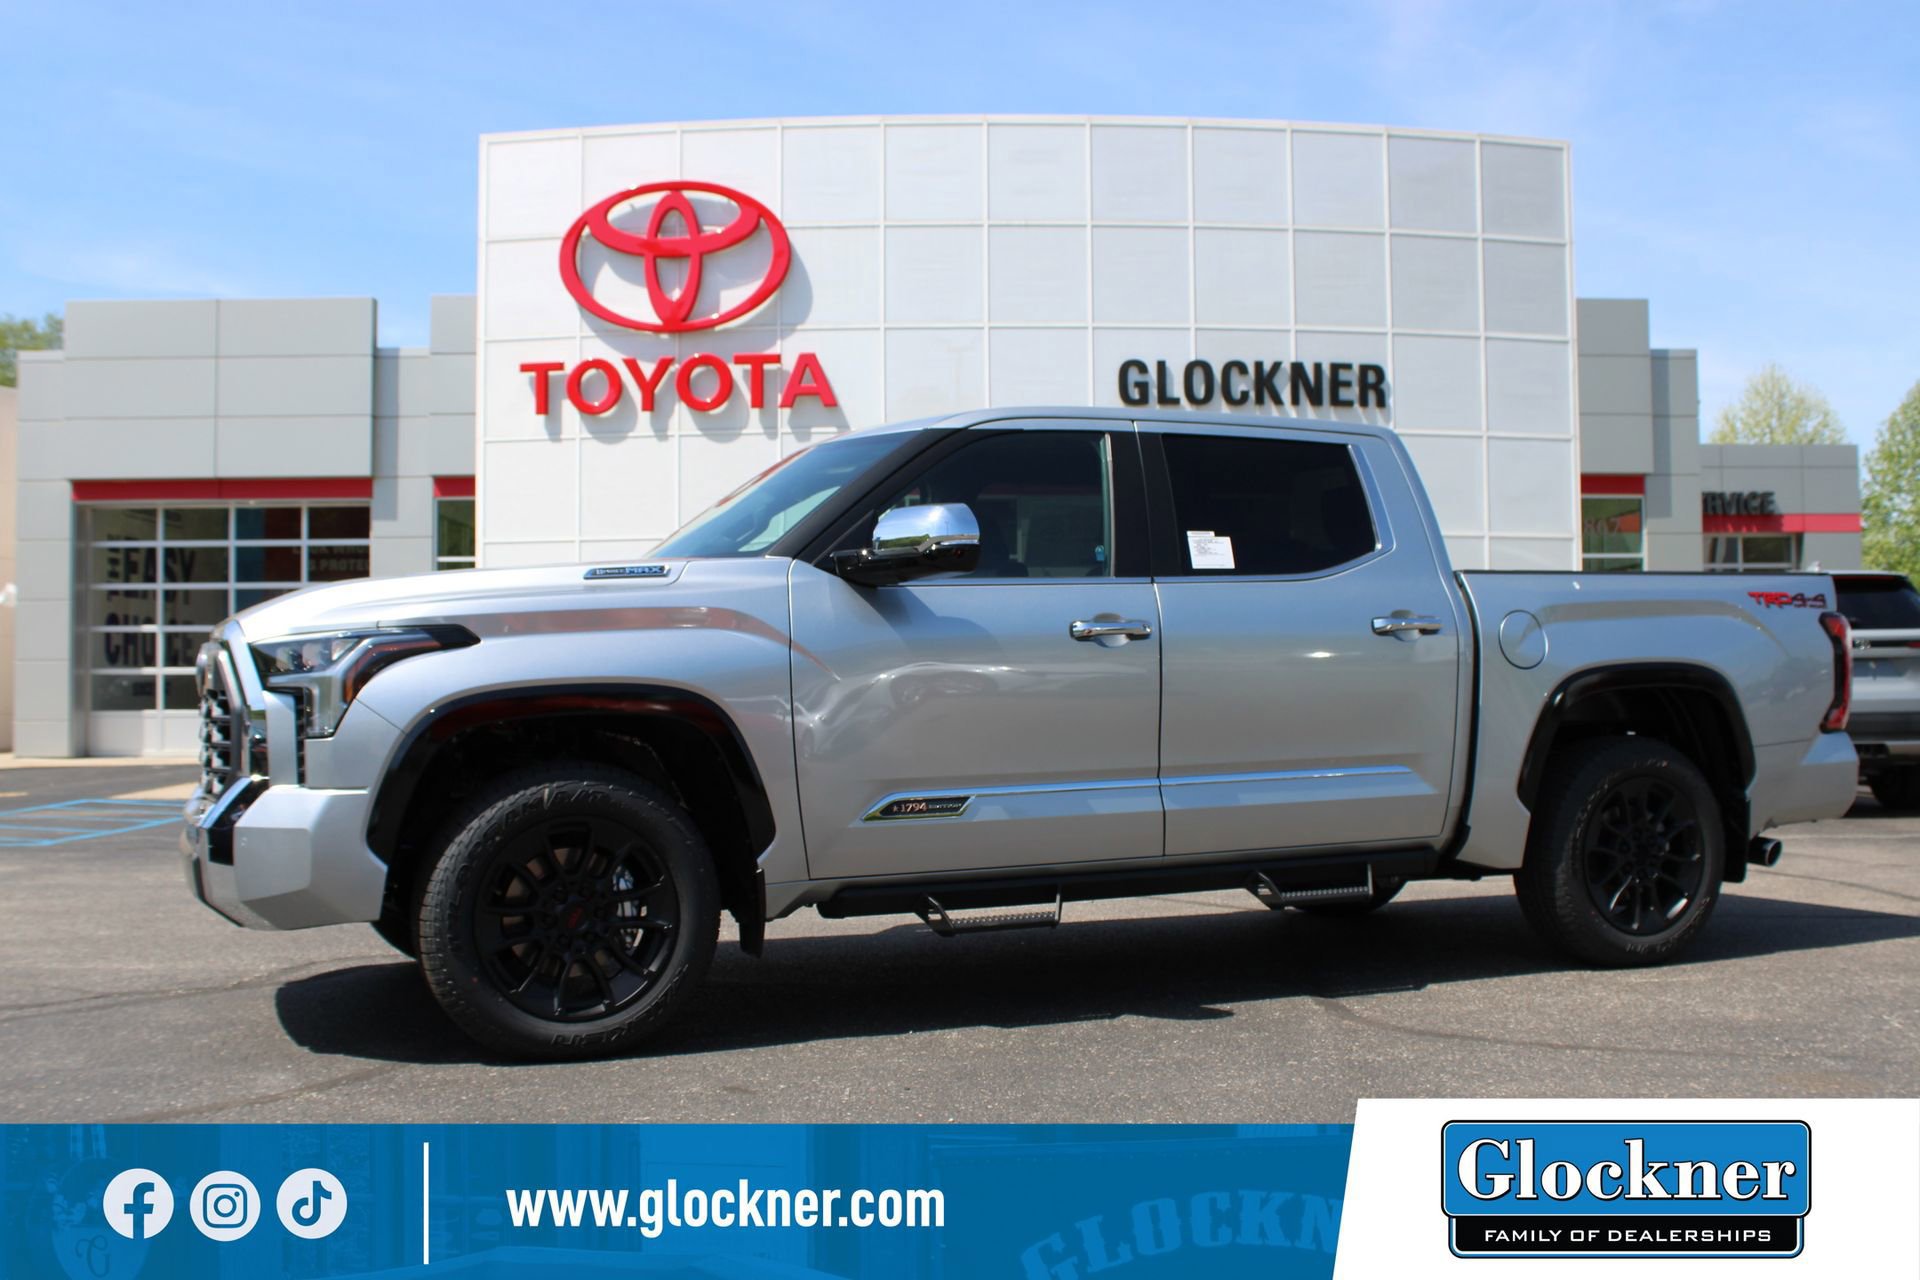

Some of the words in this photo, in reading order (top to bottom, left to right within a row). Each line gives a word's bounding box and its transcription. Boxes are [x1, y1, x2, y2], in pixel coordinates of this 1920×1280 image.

[519, 352, 838, 415] TOYOTA
[1118, 359, 1387, 408] GLOCKNER
[1702, 491, 1776, 514] RVICE
[123, 536, 196, 605] EASY
[104, 613, 194, 667] CHOCE
[900, 802, 928, 812] 1794
